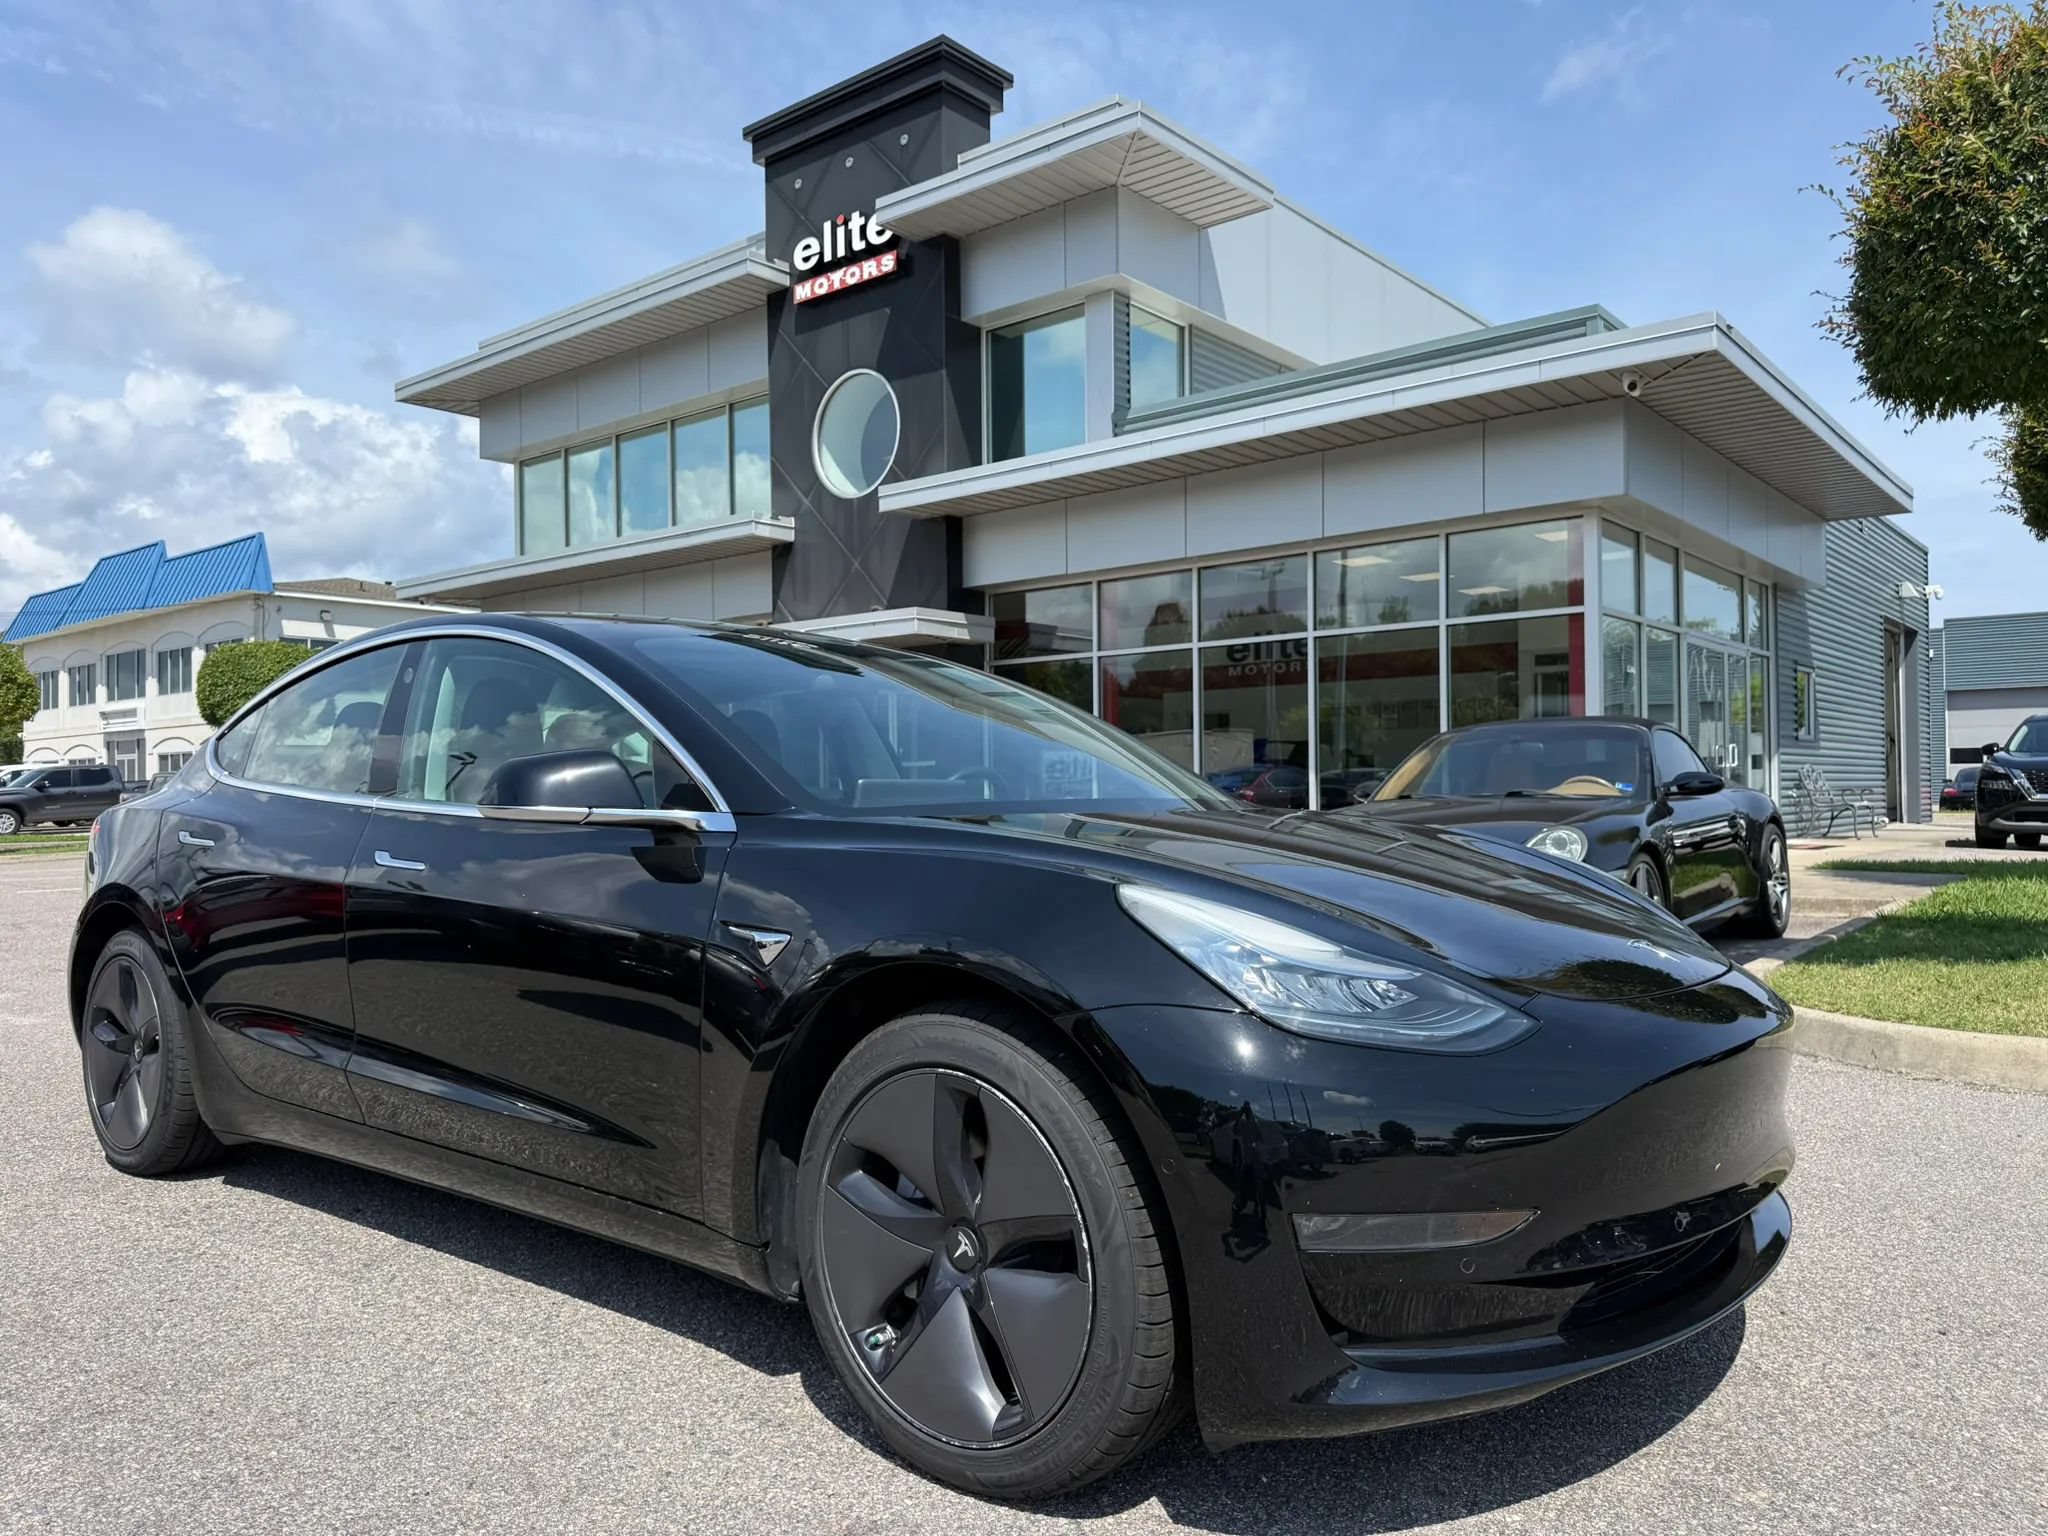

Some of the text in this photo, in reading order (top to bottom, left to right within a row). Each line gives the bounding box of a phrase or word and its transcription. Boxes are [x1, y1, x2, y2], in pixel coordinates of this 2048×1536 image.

[793, 210, 894, 271] elite
[795, 254, 895, 301] MOTORS
[1228, 661, 1308, 677] MOTOR
